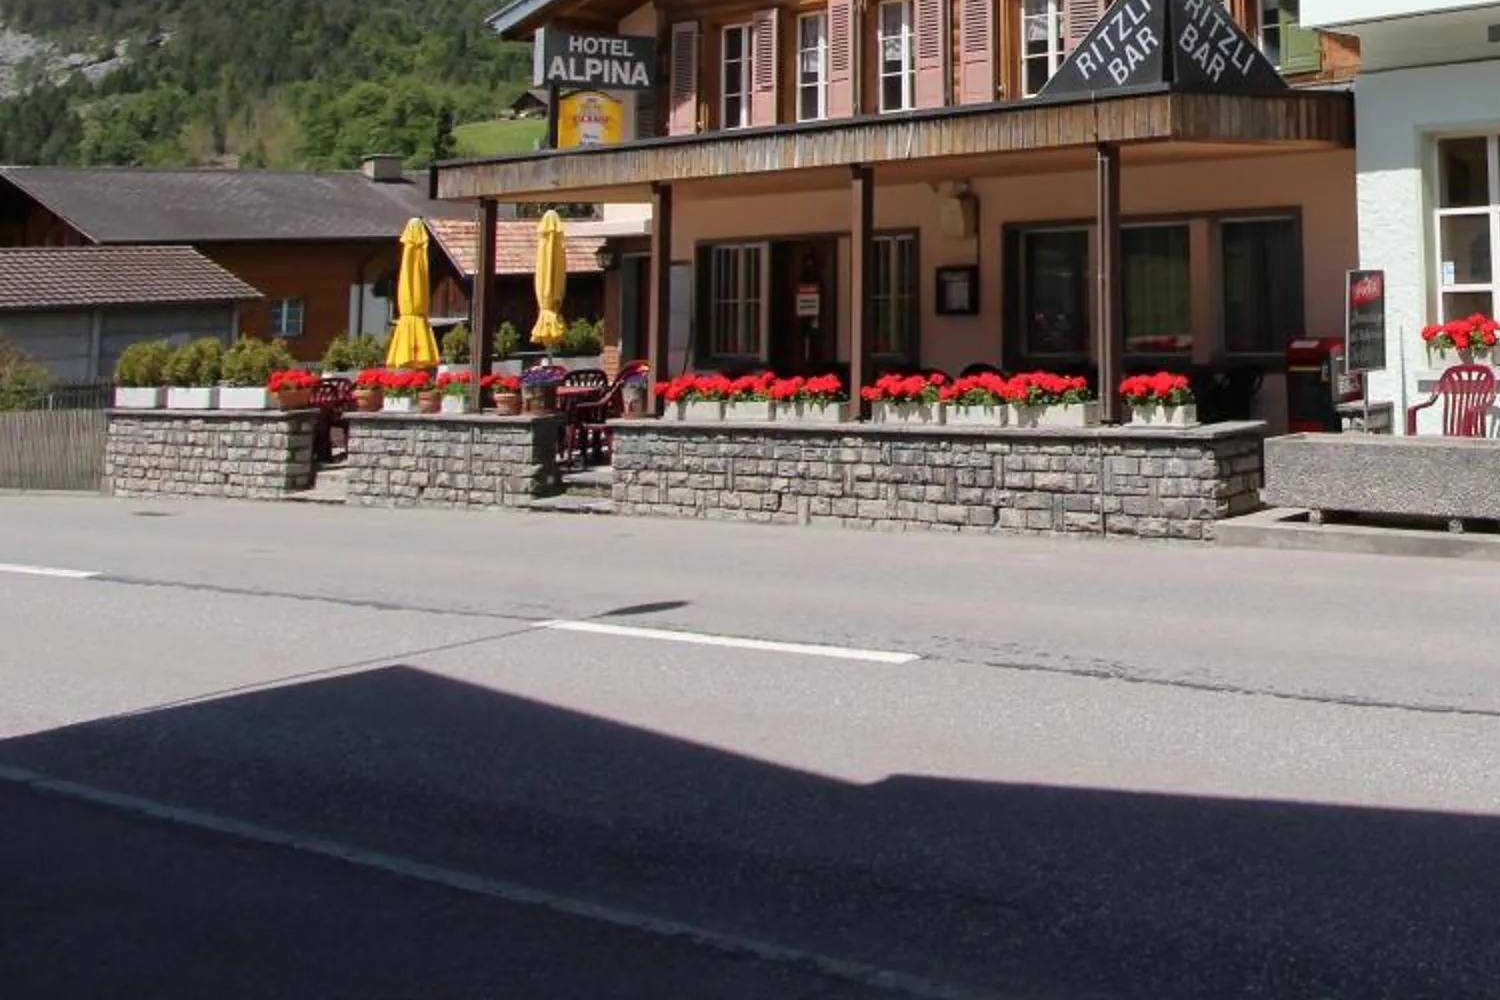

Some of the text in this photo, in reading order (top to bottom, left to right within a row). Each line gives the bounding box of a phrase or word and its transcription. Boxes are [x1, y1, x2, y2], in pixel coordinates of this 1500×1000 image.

[569, 36, 634, 56] HOTEL
[1107, 26, 1159, 85] BAR
[1178, 24, 1226, 83] BAR
[548, 56, 649, 85] ALPINA
